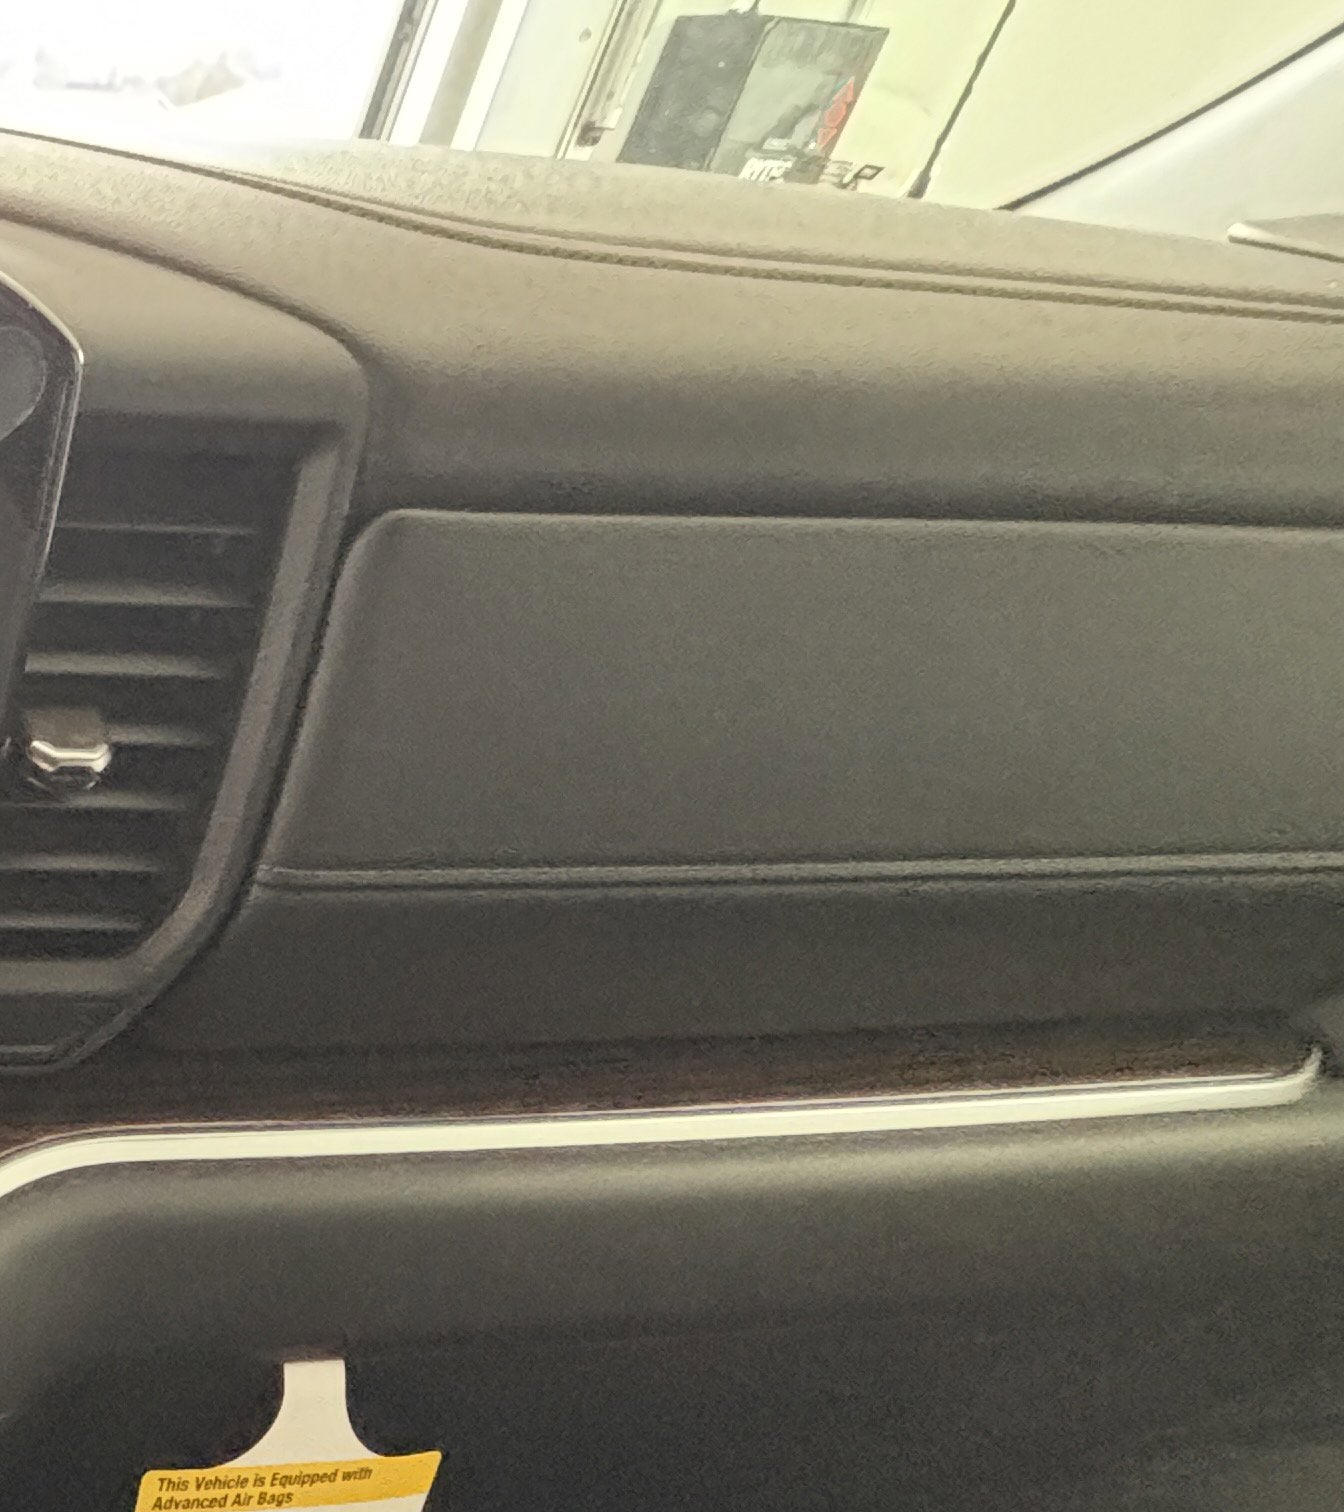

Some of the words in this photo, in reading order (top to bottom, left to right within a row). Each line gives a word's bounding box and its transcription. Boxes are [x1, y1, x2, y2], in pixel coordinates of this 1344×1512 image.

[157, 1476, 189, 1492] This
[195, 1473, 249, 1491] Vehicle
[253, 1473, 266, 1487] is
[270, 1468, 338, 1489] Equipped
[342, 1466, 373, 1482] with
[151, 1492, 227, 1511] Advanced
[232, 1492, 253, 1507] Air
[257, 1490, 295, 1508] Bags
